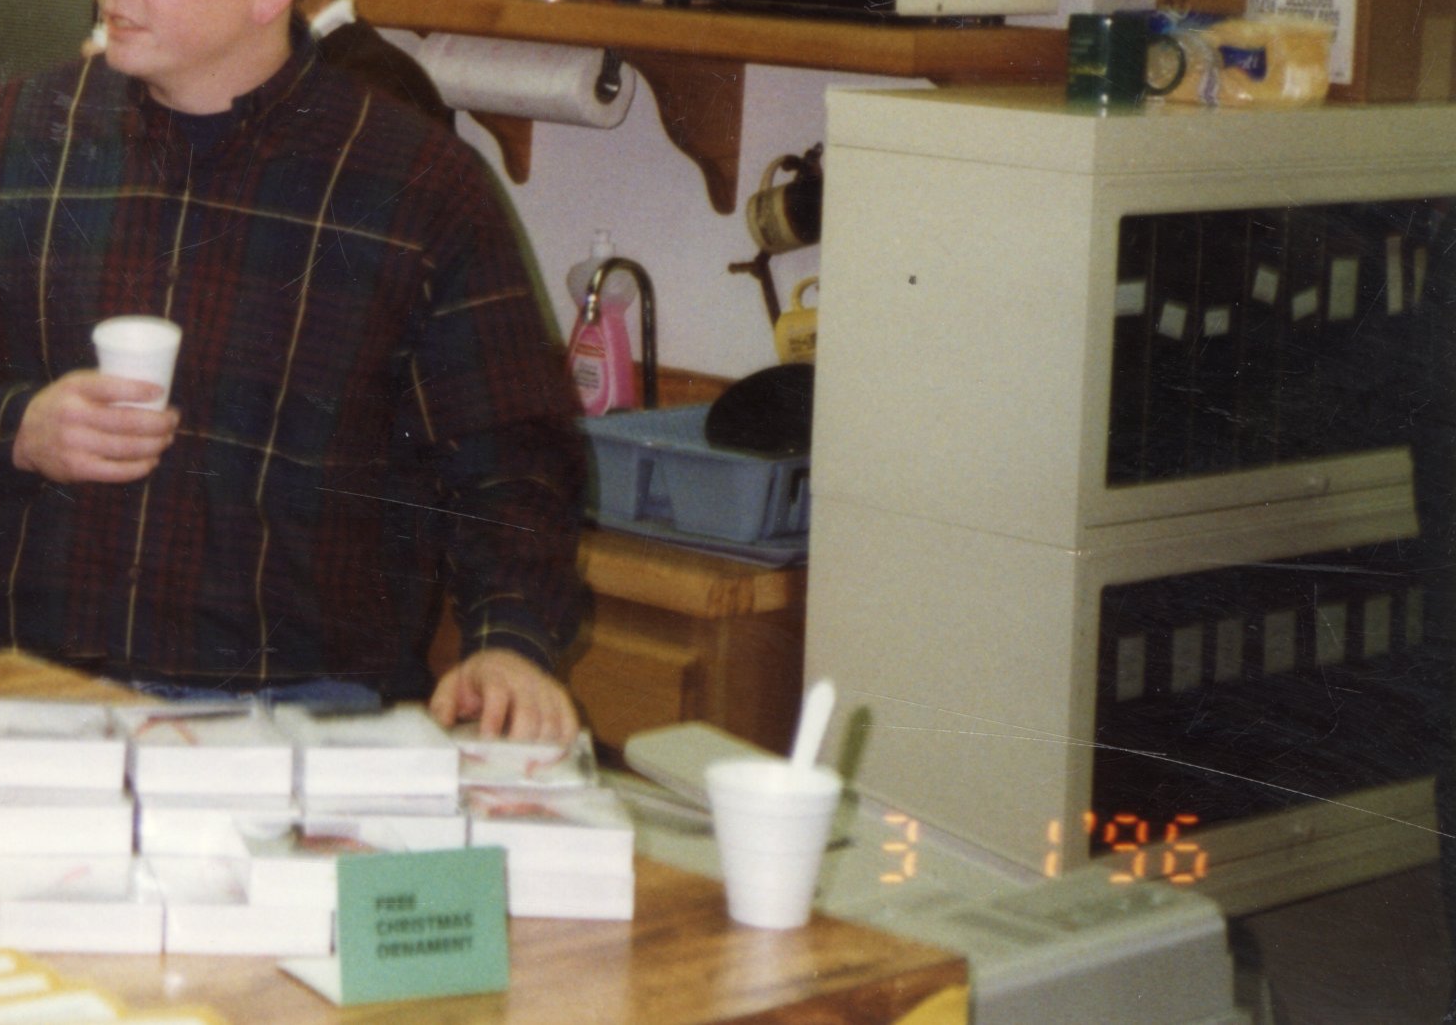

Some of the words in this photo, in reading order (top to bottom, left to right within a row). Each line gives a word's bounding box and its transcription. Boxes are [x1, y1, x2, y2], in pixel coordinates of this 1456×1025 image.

[375, 894, 416, 912] FREE
[375, 913, 474, 935] CHRISTMAS
[376, 935, 473, 959] ORNAMENT
